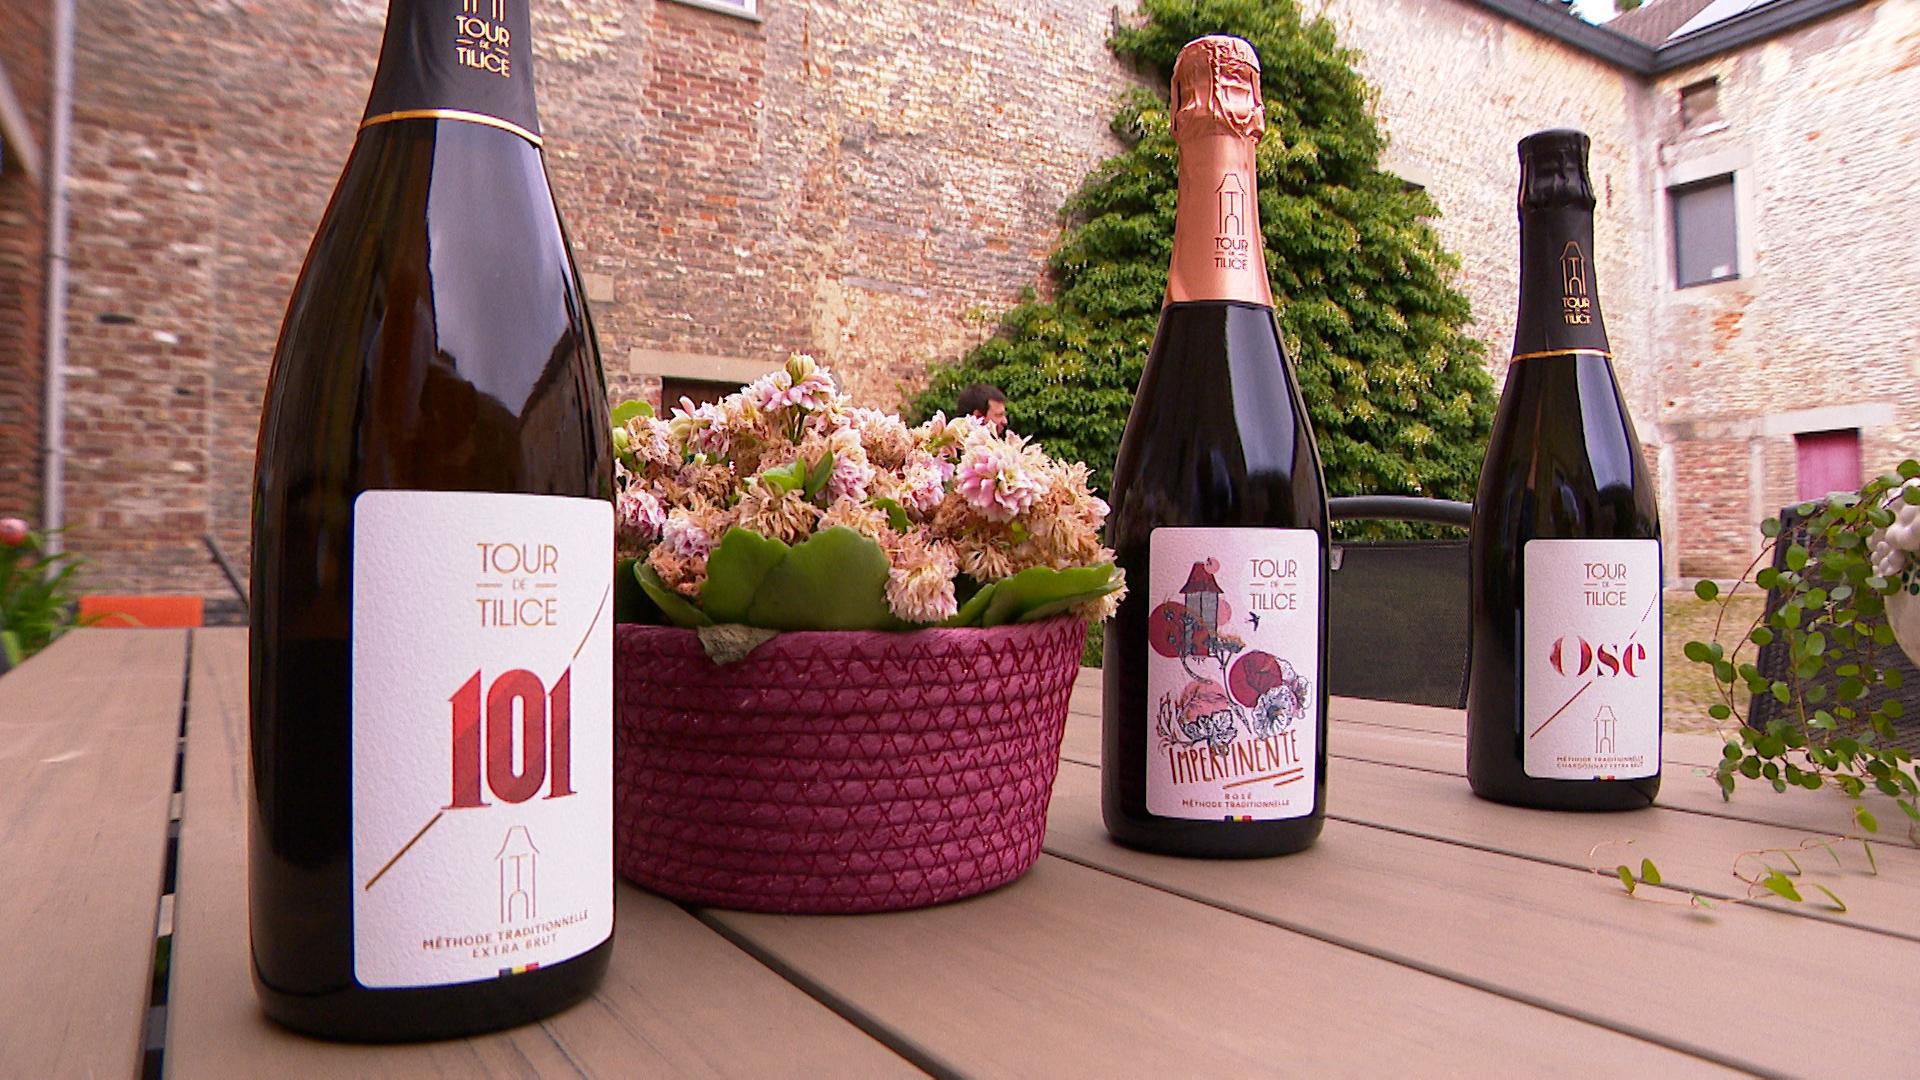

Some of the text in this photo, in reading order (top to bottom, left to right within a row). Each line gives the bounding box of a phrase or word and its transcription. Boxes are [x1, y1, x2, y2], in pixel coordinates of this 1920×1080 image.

[455, 15, 511, 48] TOUR
[455, 46, 511, 78] TILICE
[1214, 237, 1248, 252] TOUR
[1214, 257, 1248, 271] TILICE
[1562, 297, 1590, 308] TOUR
[476, 542, 559, 574] TOUR
[1249, 559, 1297, 578] TOUR
[1583, 563, 1627, 579] TOUR
[513, 579, 527, 591] DE
[1249, 593, 1297, 610] TILICE
[1583, 591, 1627, 606] TILICE
[476, 598, 558, 628] TILICE
[441, 664, 577, 811] 101
[1182, 798, 1222, 808] MÉTHODE
[422, 909, 589, 950] MÉTHODE TRADITIONNELLE
[472, 933, 557, 959] EXTRA BRUT
